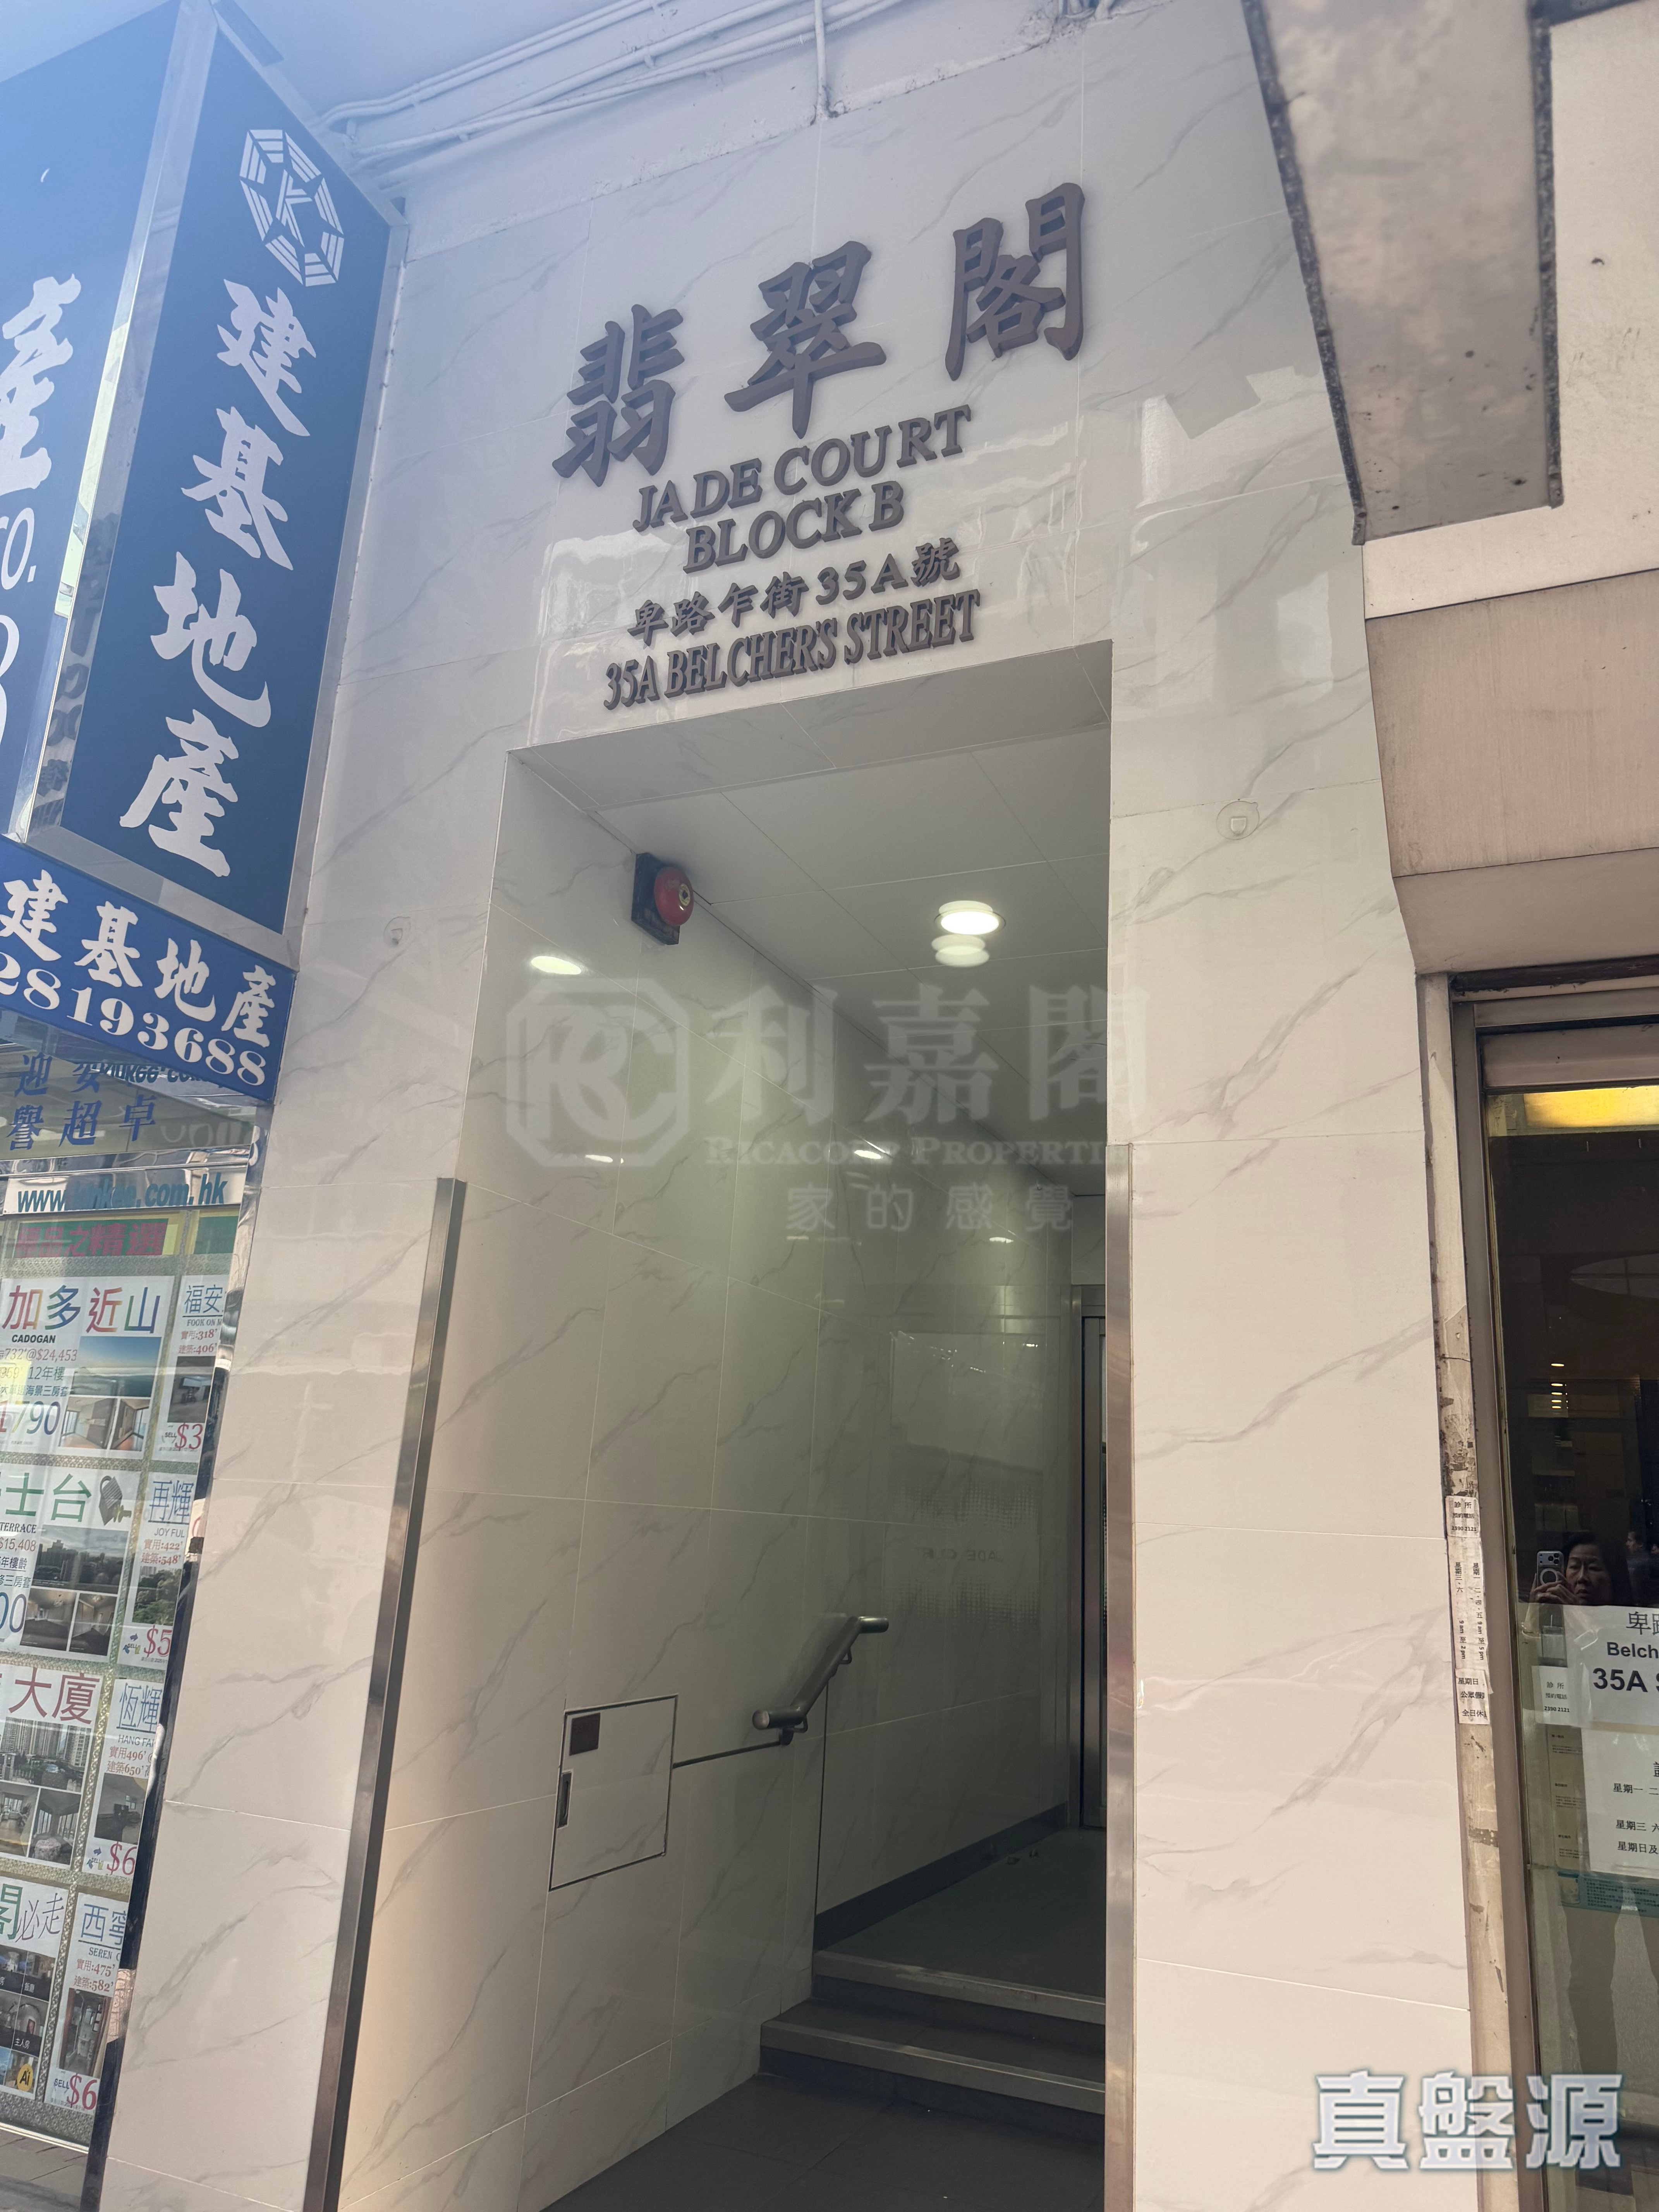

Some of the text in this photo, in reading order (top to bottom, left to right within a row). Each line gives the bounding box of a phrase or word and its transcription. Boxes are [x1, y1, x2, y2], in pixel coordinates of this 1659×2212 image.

[552, 182, 1085, 487] 翡翠閣
[633, 404, 971, 532] JADE COURT
[683, 480, 905, 574] BLOCK B
[120, 278, 316, 877] 建基地產
[603, 589, 980, 710] 35A BELCHER'S STREET
[0, 869, 276, 1048] 建基地產
[0, 952, 266, 1086] 28193688
[2, 1285, 160, 1334] 加多近山
[12, 1334, 56, 1343] CADOGAN
[1607, 1642, 1659, 1659] Belch
[1593, 1668, 1648, 1693] 35A
[118, 1735, 140, 1746] HANG
[88, 1947, 113, 1960] SEREN
[54, 2078, 70, 2089] SELL
[66, 2073, 98, 2110] $6
